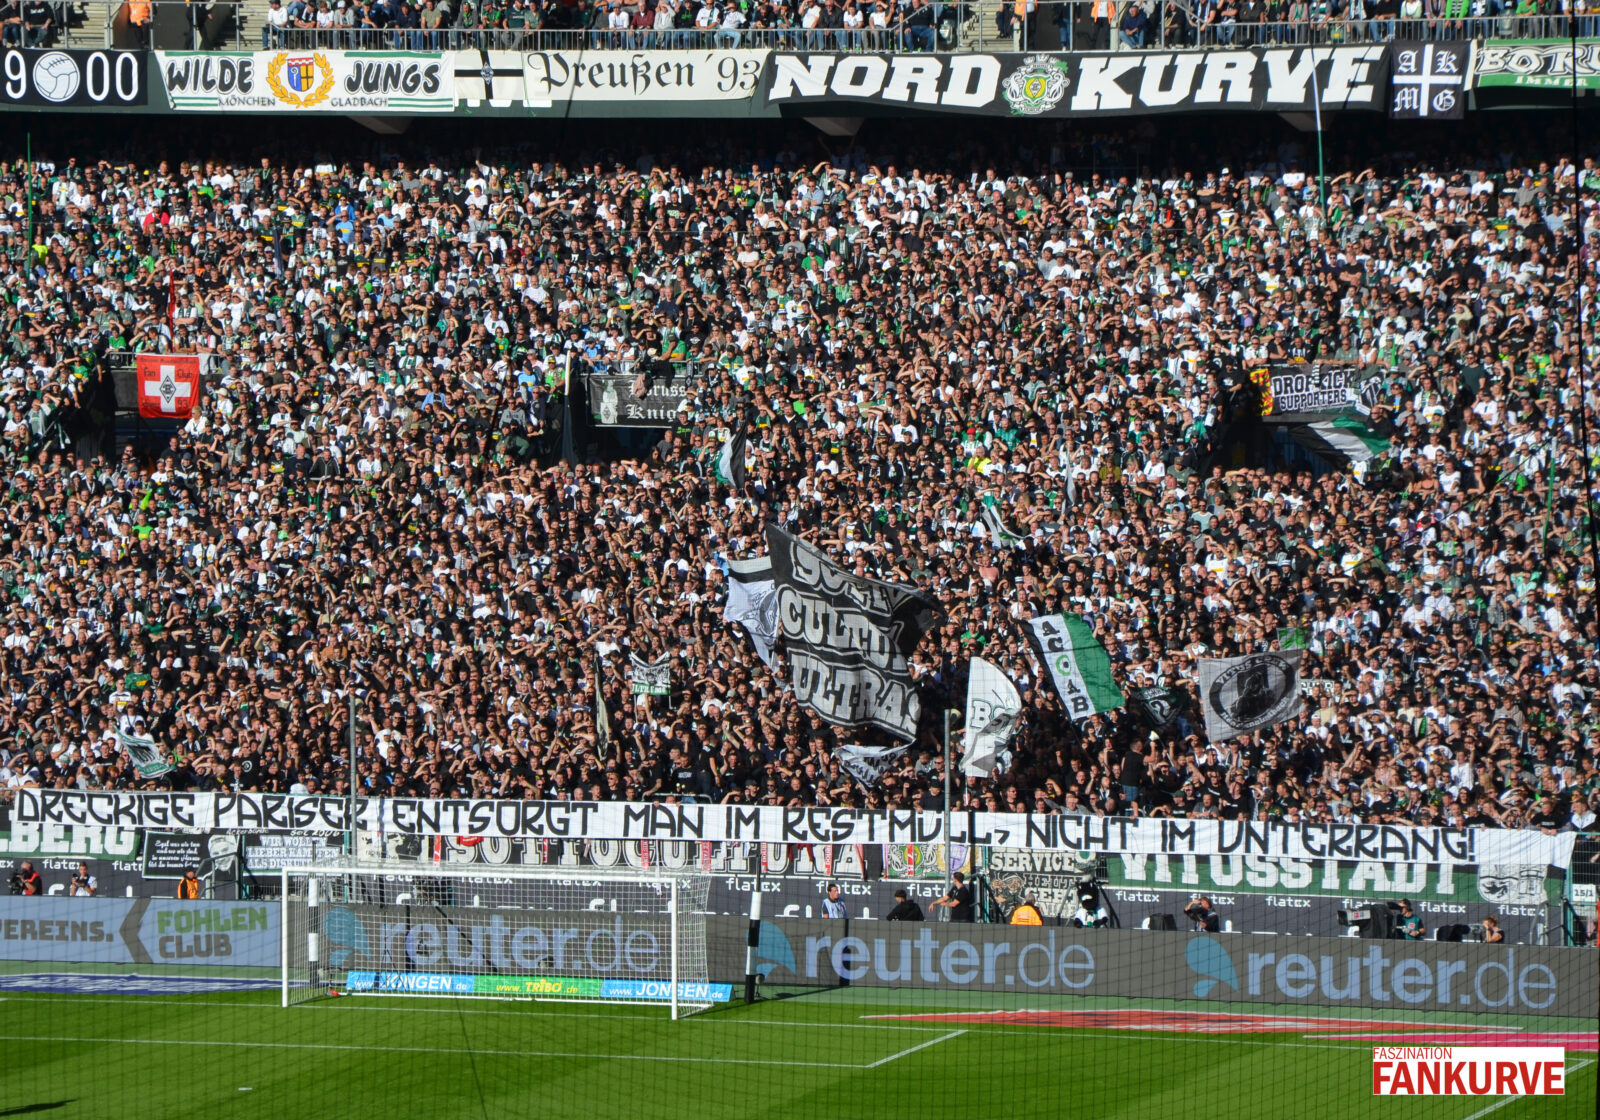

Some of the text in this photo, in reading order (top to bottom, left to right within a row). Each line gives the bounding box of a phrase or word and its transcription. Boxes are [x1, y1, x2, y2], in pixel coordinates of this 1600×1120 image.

[167, 56, 441, 95] WILDE JUNGS
[527, 52, 694, 96] Preußen
[769, 46, 1385, 111] NORD KURVE
[1515, 75, 1588, 86] IMMER
[218, 94, 388, 108] MÖNCHEN GLADBACH
[1280, 388, 1348, 411] SUPPORTERS
[17, 789, 195, 827] DRECKIGE
[214, 792, 368, 830] PARISER
[392, 800, 598, 836] ENTSORGT
[623, 804, 704, 838] MAN
[725, 806, 760, 840] IM
[1026, 814, 1139, 850] NICHT
[1161, 819, 1196, 851] IM
[1218, 820, 1475, 862] UNTERRANG!
[990, 853, 1076, 872] SERVICE
[1115, 891, 1160, 902] flatex
[1265, 896, 1311, 908] flatex
[1575, 888, 1594, 897] 15/1
[1419, 902, 1466, 913] flatex
[0, 919, 114, 942] EREINS.
[157, 907, 268, 934] FOHLEN
[159, 934, 233, 958] CLUB
[382, 914, 660, 972] reuter.de
[805, 928, 1095, 988] reuter.de
[1248, 945, 1557, 1009] reuter.de
